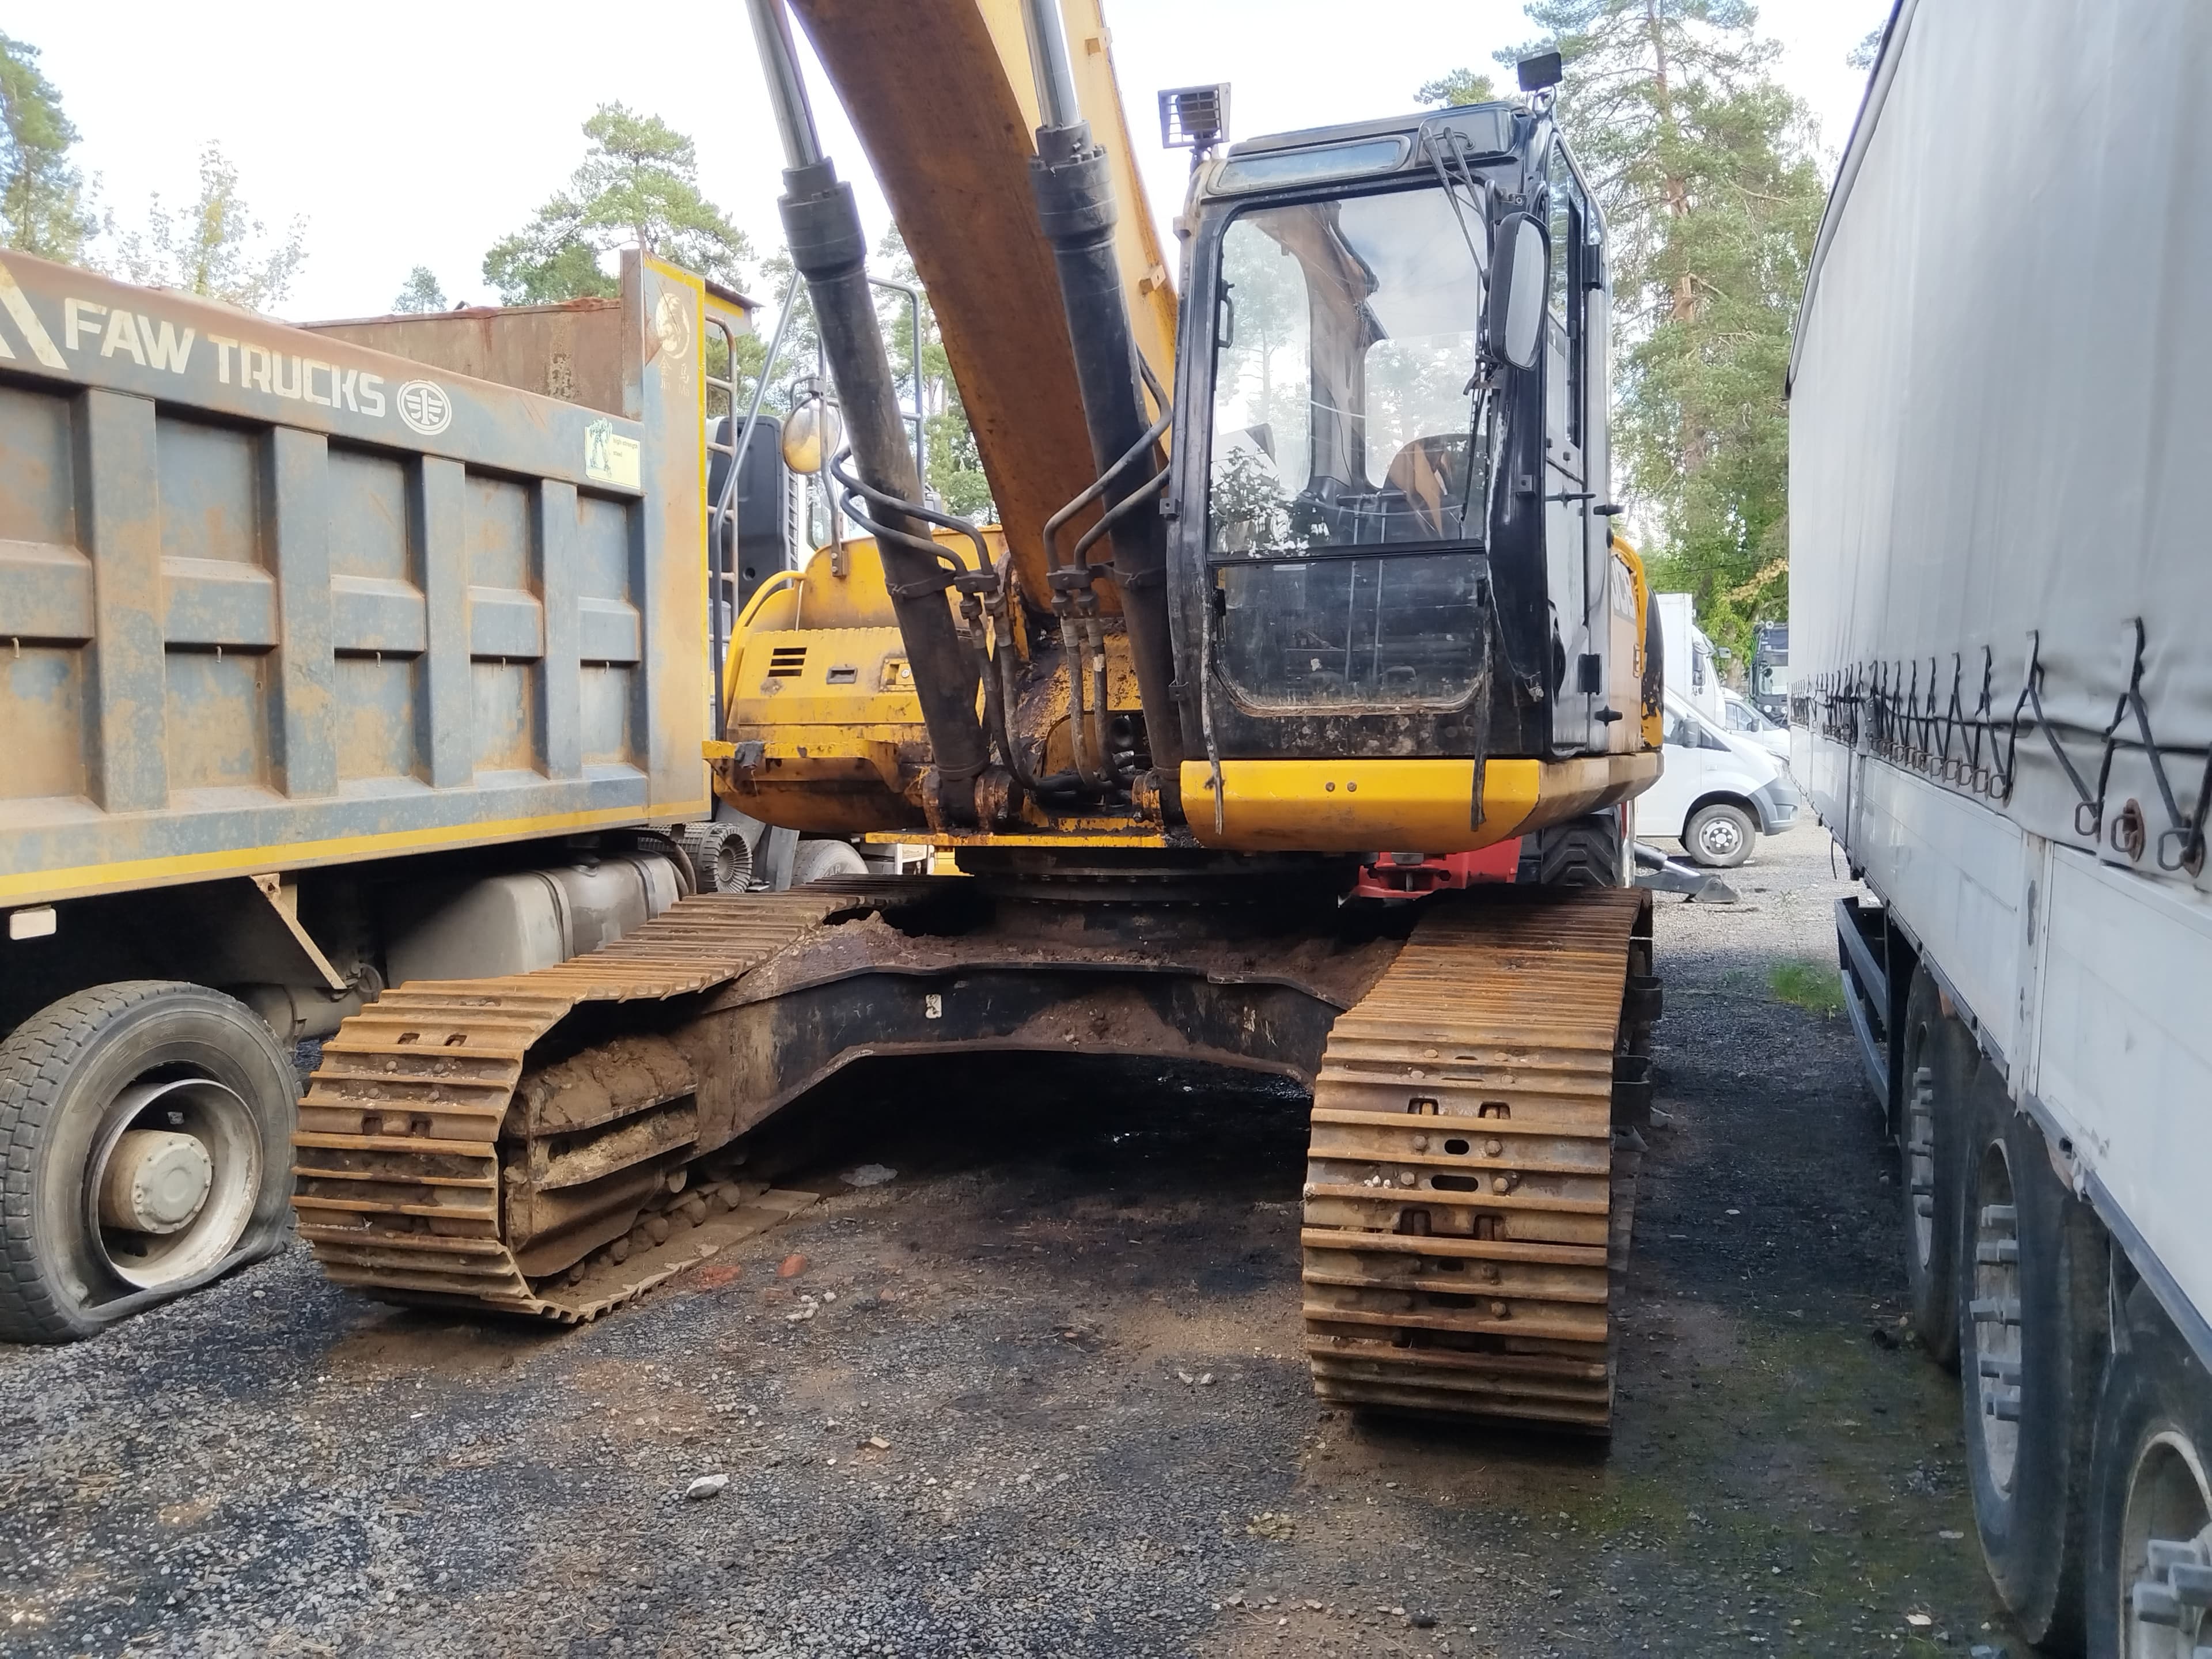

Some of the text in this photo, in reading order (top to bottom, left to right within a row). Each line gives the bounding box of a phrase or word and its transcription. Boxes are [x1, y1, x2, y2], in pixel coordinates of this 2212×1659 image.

[65, 297, 385, 418] FAW TRUCKS
[1611, 556, 1636, 619] JCB
